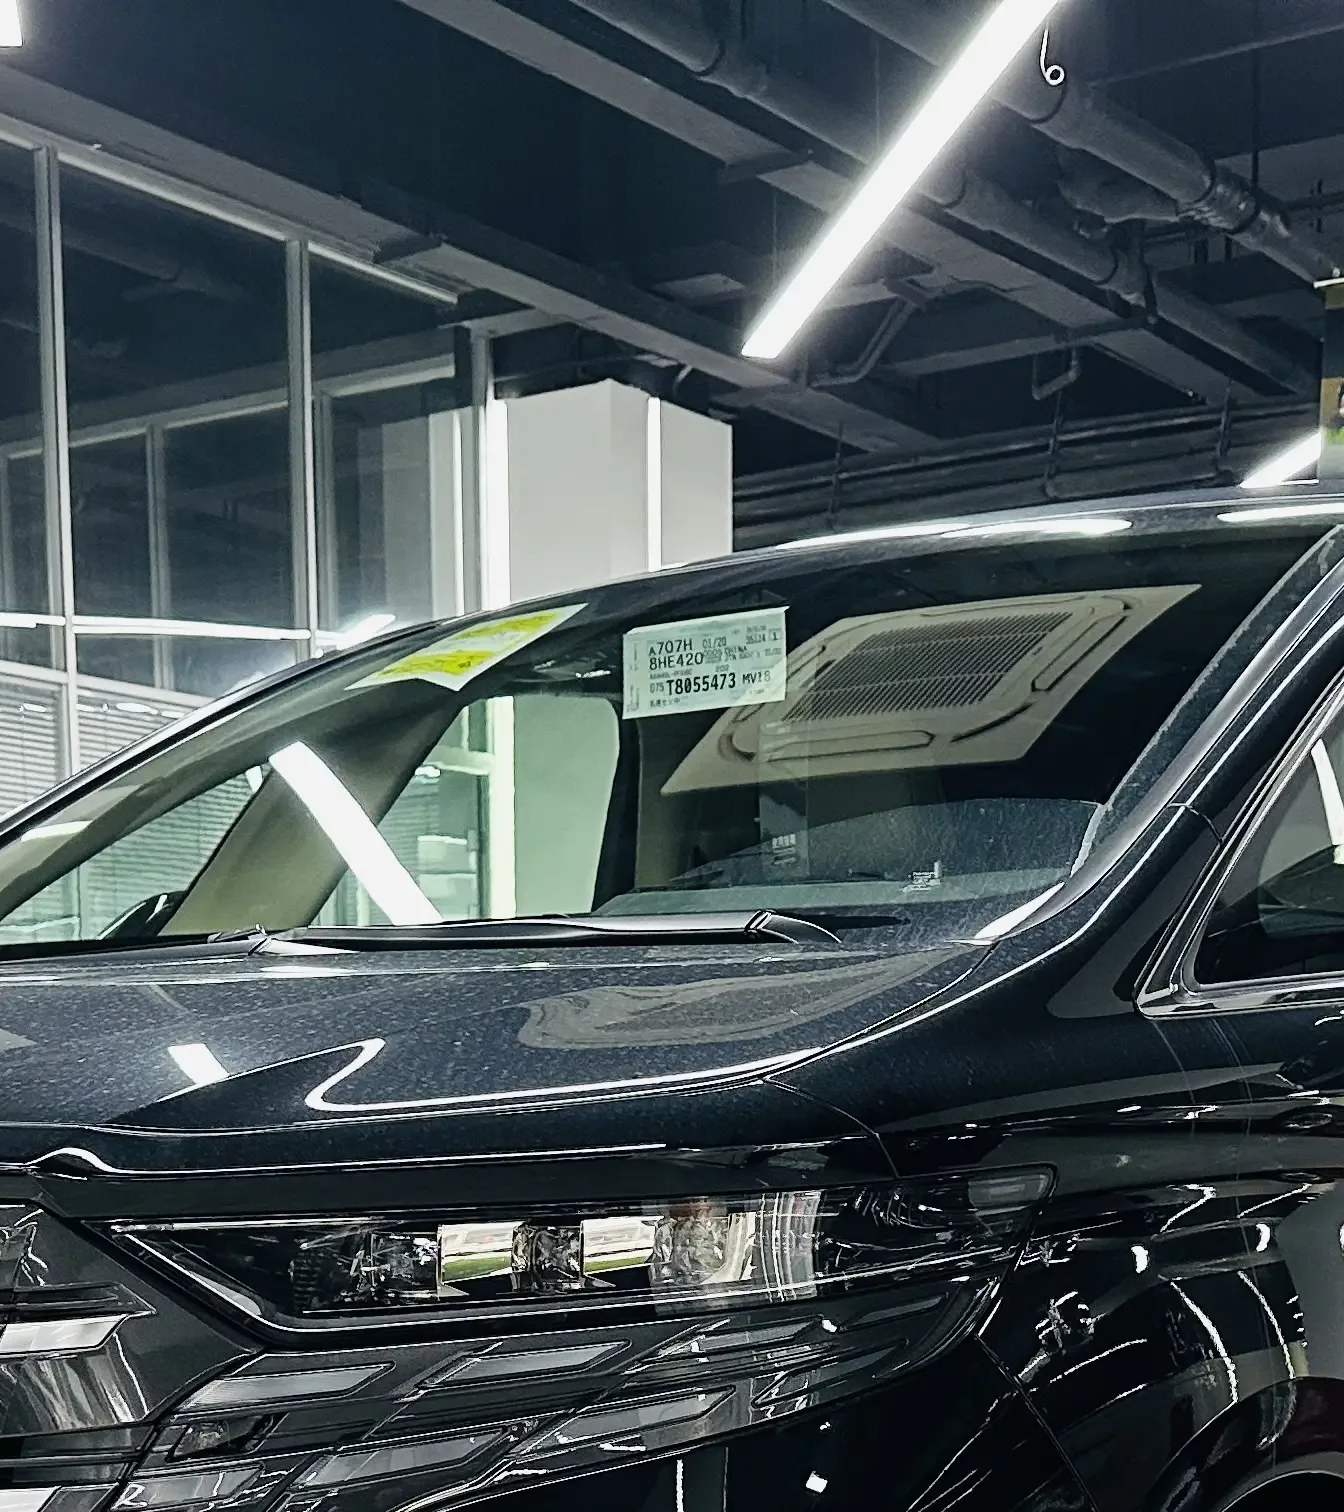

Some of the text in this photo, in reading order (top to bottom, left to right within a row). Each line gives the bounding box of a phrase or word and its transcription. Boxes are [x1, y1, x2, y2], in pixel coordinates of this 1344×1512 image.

[648, 638, 693, 657] A707H
[649, 651, 704, 671] 8HE420
[666, 672, 736, 695] T8055473
